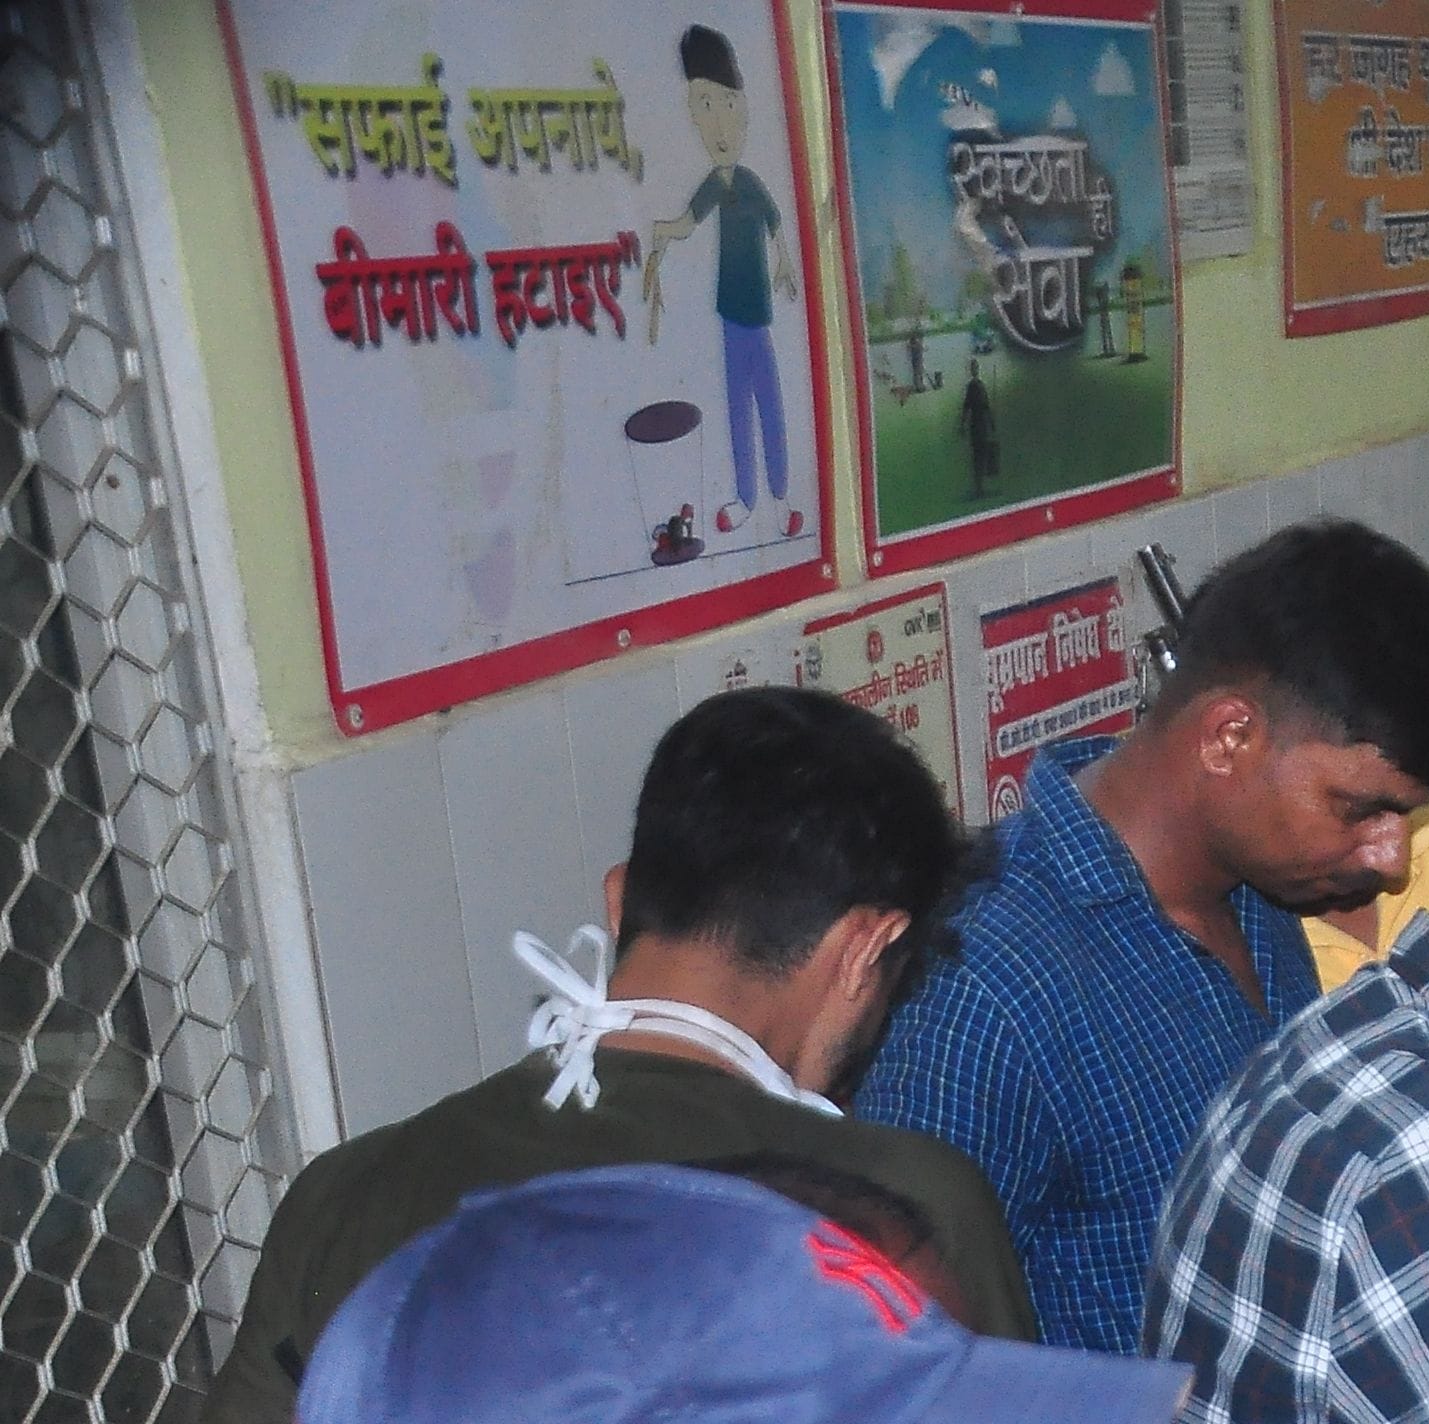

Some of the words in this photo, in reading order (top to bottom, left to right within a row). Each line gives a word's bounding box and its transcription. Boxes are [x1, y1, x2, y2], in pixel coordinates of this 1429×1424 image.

[953, 135, 1089, 206] स्वच्छता
[315, 221, 480, 350] बीमारी
[992, 214, 1095, 352] सेवा
